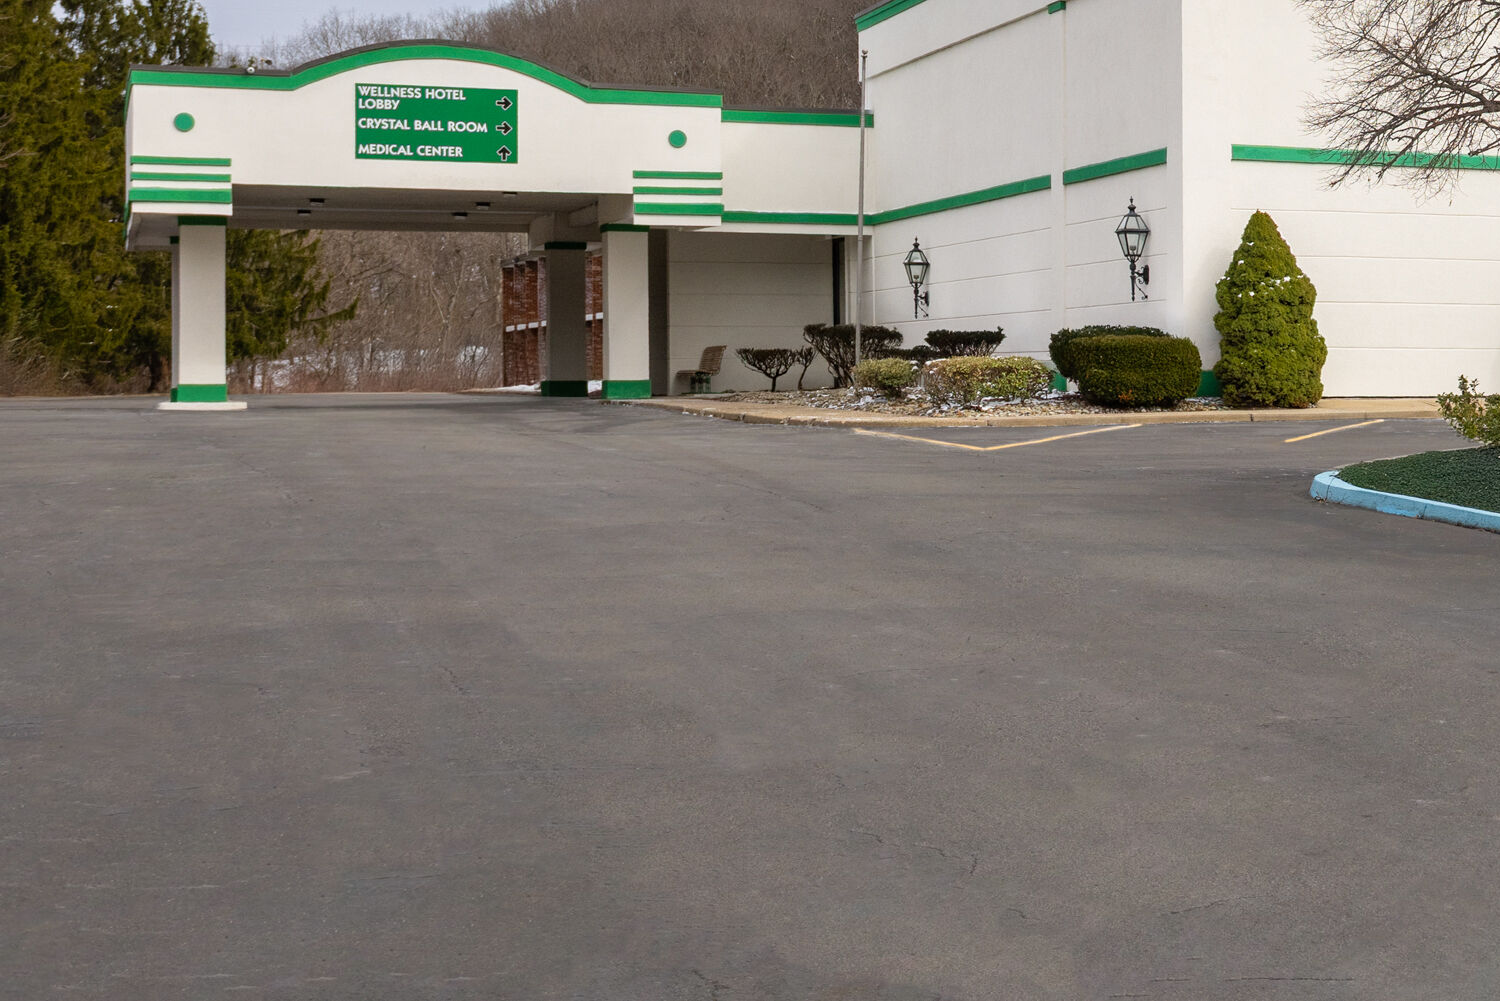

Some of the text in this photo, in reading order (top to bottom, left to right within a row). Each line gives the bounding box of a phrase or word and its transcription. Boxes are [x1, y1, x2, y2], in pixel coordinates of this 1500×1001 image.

[357, 86, 466, 100] WELLNESS HOTEL
[358, 98, 400, 110] LOBBY
[357, 118, 488, 133] CRYSTAL BALL ROOM
[357, 144, 463, 157] MEDICAL CENTER
